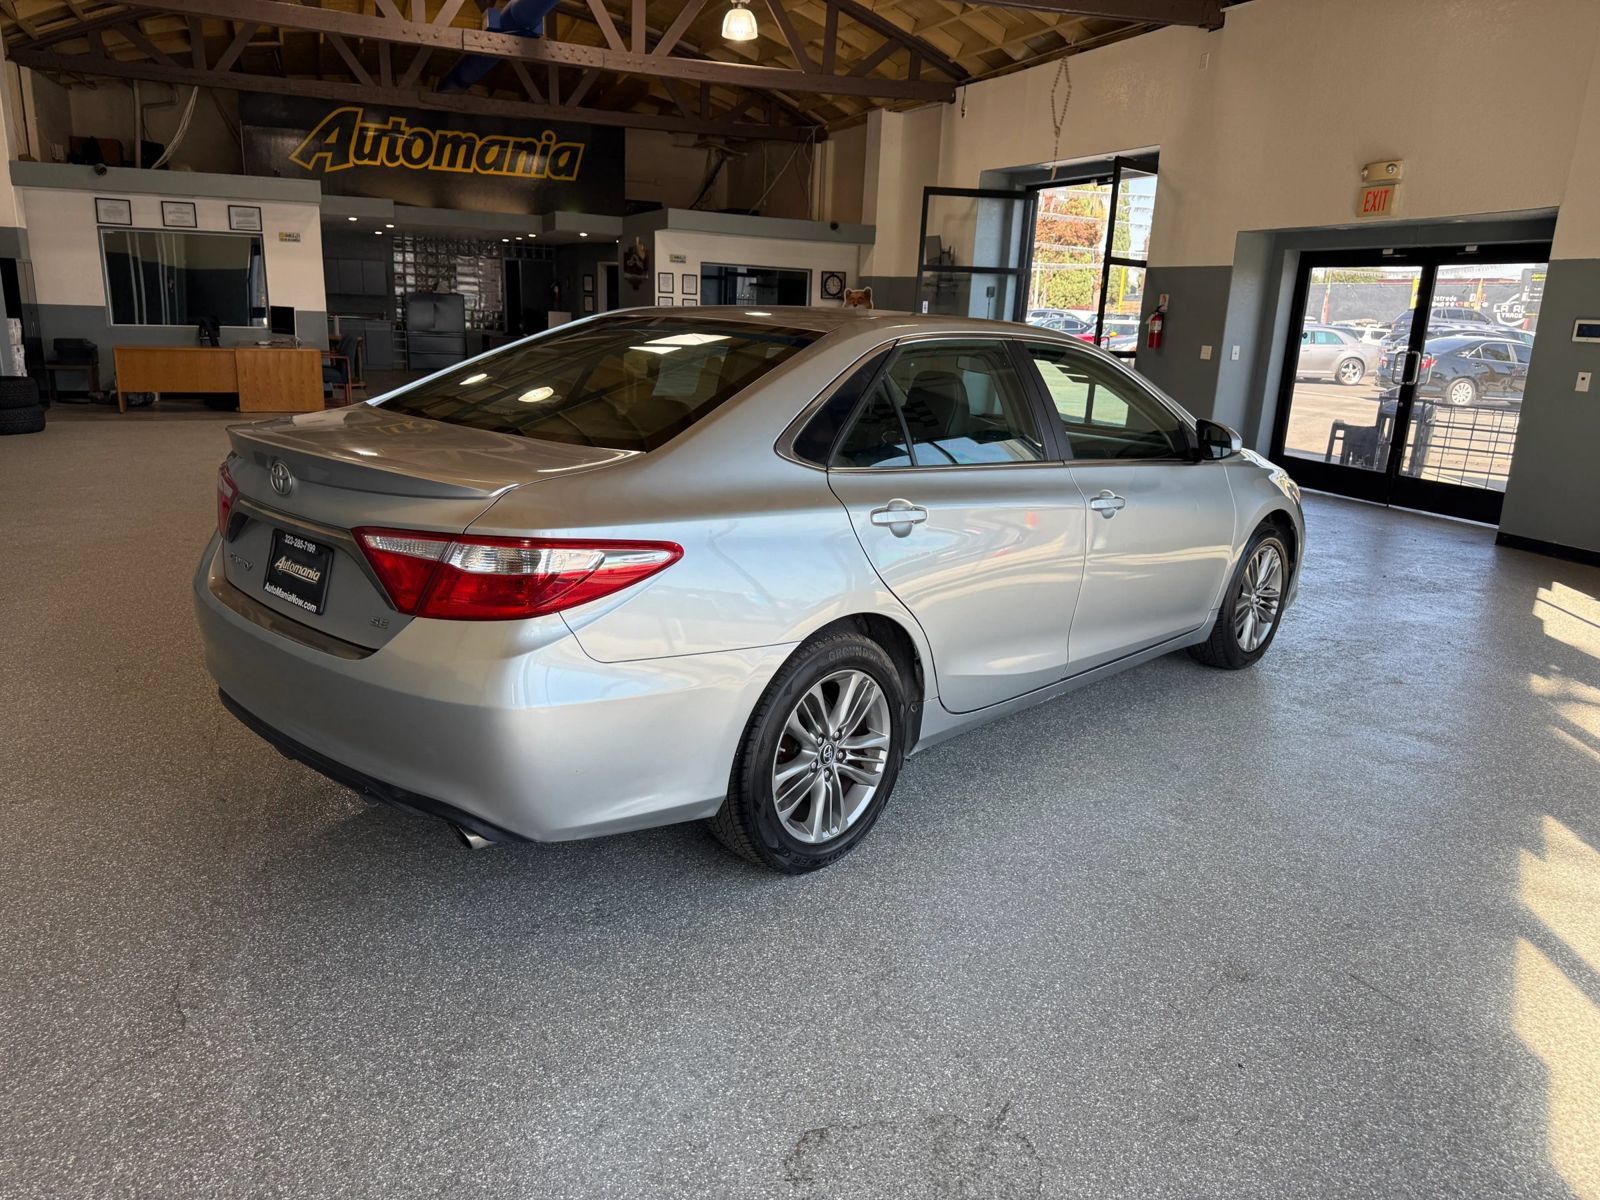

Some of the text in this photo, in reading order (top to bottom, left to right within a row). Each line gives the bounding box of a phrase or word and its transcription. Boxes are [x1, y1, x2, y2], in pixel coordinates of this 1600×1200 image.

[289, 106, 585, 181] Automania
[1363, 188, 1390, 212] EXIT
[274, 556, 321, 581] Automania
[264, 582, 317, 613] AutoManiaNow.com
